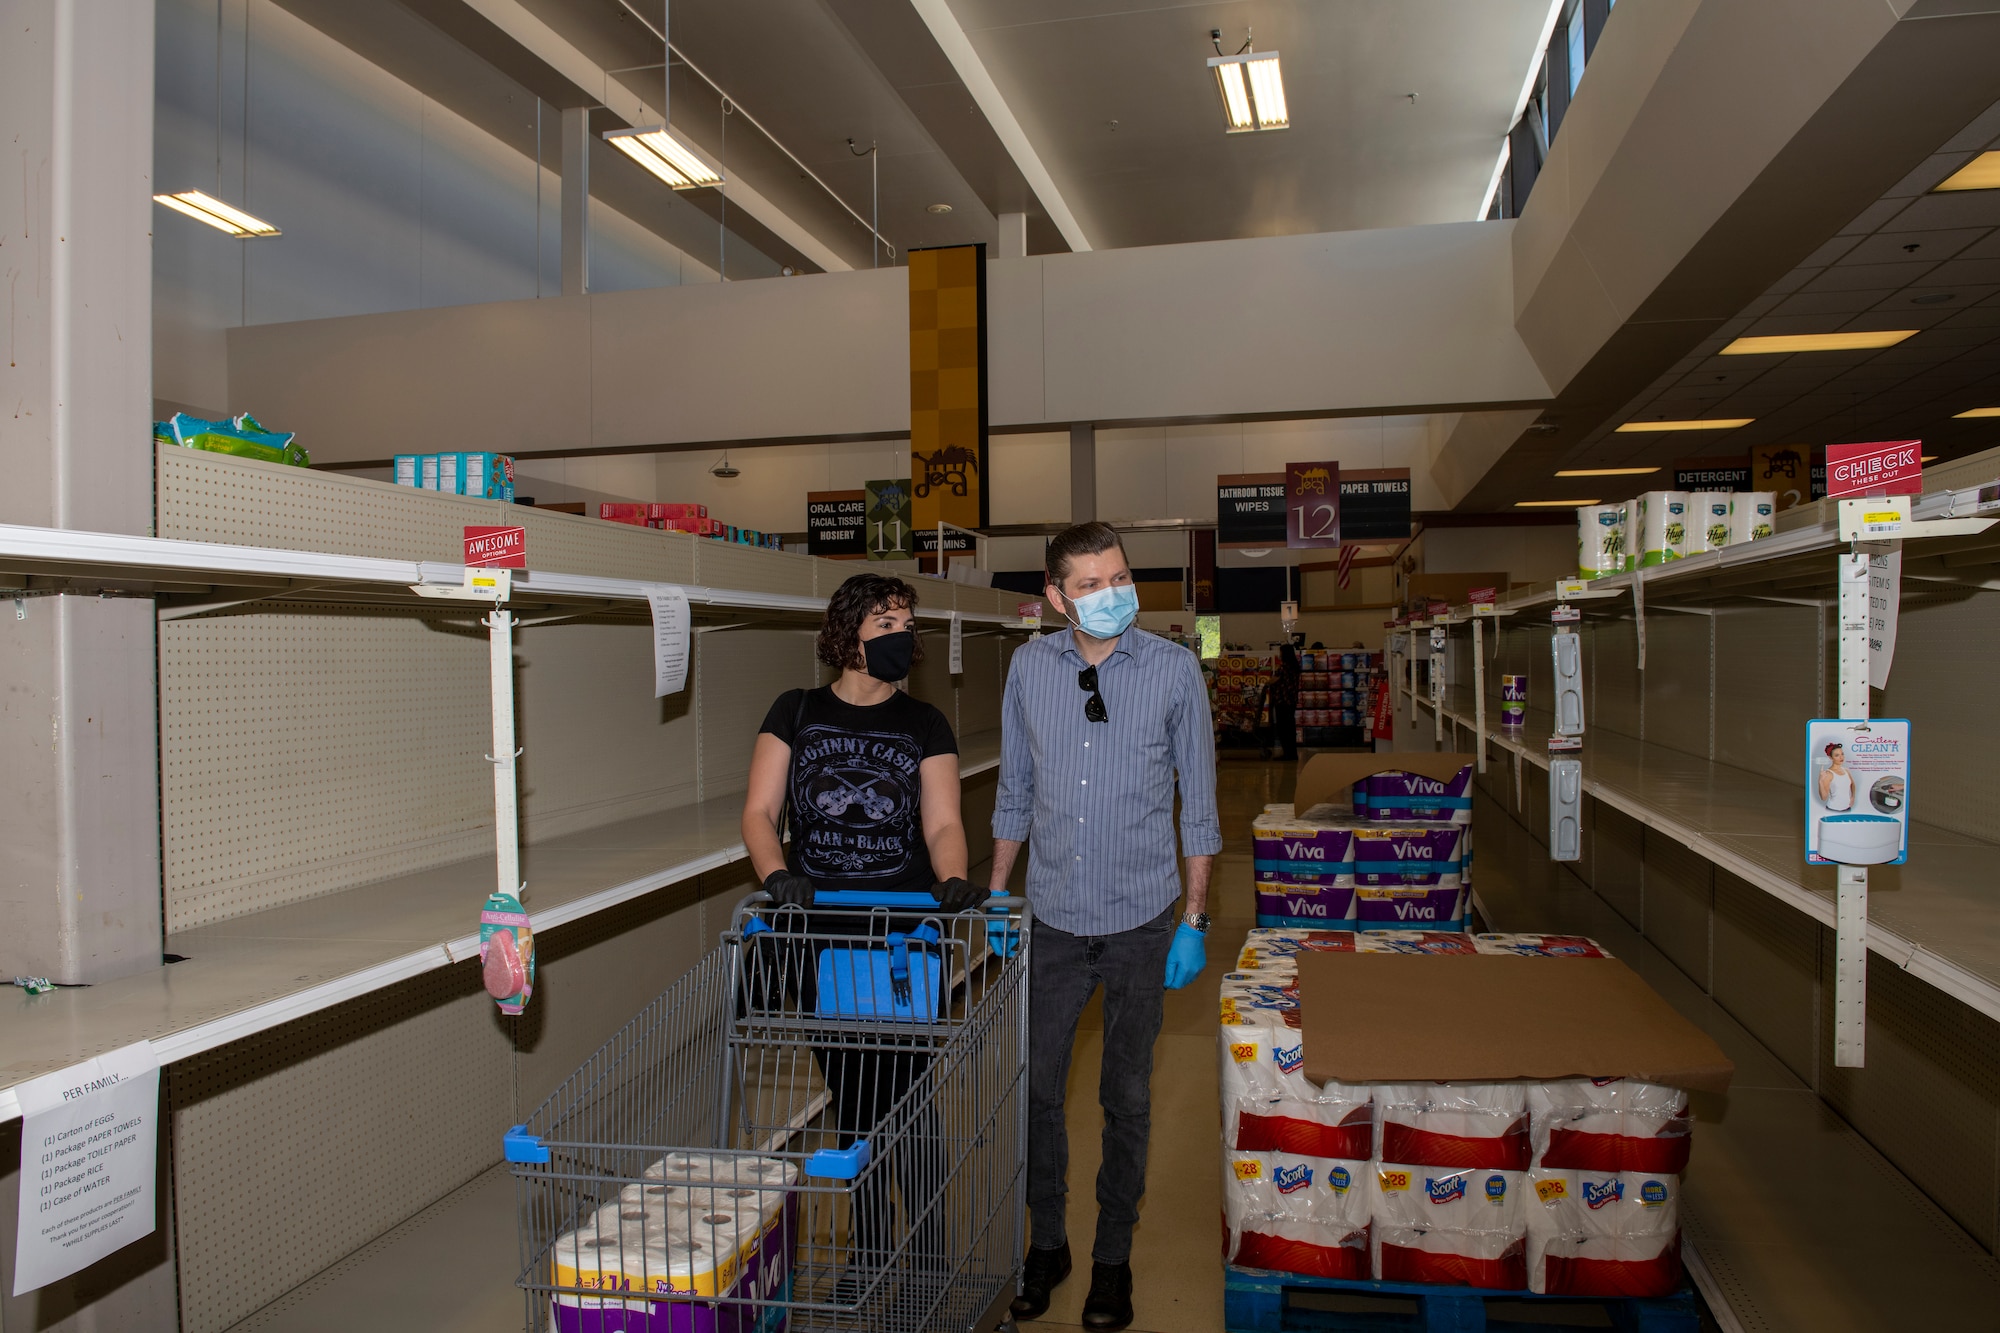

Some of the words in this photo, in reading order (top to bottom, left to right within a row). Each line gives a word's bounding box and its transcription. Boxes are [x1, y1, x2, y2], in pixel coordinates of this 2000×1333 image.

[1834, 448, 1915, 482] CHECK
[1678, 470, 1747, 483] DETERGENT
[1851, 474, 1879, 487] THESE
[1882, 469, 1900, 479] OUT
[1219, 487, 1257, 499] BATHROOM
[1259, 486, 1285, 497] TISSUE
[1341, 483, 1369, 494] PAPER
[1372, 482, 1408, 493] TOWELS
[810, 503, 836, 513] ORAL
[838, 502, 865, 513] CARE
[1235, 501, 1270, 512] WIPES
[810, 517, 837, 527] FACIAL
[837, 516, 864, 526] TISSUE
[1292, 504, 1336, 541] 12
[820, 530, 855, 541] HOSIERY
[872, 520, 907, 553] 11
[1665, 527, 1685, 540] Huge
[1707, 528, 1728, 541] Huge
[468, 532, 520, 555] AWESOME
[923, 539, 967, 550] VITMINS
[481, 549, 507, 559] OPTIONS
[1872, 576, 1884, 588] ITEM
[1885, 578, 1890, 590] IS
[1880, 598, 1887, 610] TO
[1875, 618, 1885, 632] PER
[1504, 687, 1526, 701] Viva
[1378, 692, 1389, 731] UNEXPECTED
[1855, 736, 1899, 747] Cutlery
[800, 737, 870, 767] JOHNNY
[872, 742, 918, 776] CASH
[1404, 776, 1445, 795] Viva
[809, 829, 843, 847] MAN
[857, 834, 903, 851] BLACK
[1284, 841, 1325, 860] Viva
[1392, 840, 1433, 860] Viva
[1287, 897, 1327, 917] Viva
[1394, 901, 1435, 920] Viva
[485, 912, 526, 923] Anti-Cellulite
[1238, 1046, 1253, 1057] 28
[62, 1085, 84, 1101] PER
[84, 1073, 129, 1096] FAMILY...
[44, 1135, 56, 1148] (1)
[57, 1124, 83, 1142] Carton
[84, 1119, 94, 1132] of
[94, 1113, 115, 1128] EGGS
[41, 1152, 54, 1165] (1)
[54, 1140, 86, 1160] Package
[87, 1130, 112, 1146] PAPER
[113, 1116, 142, 1134] TOWELS
[41, 1168, 53, 1181] (1)
[54, 1156, 86, 1175] Package
[87, 1145, 113, 1160] TOILET
[114, 1134, 137, 1150] PAPER
[1242, 1163, 1258, 1174] 28
[1279, 1163, 1305, 1186] Scott
[1331, 1171, 1347, 1180] MORE
[40, 1184, 52, 1197] (1)
[53, 1172, 86, 1190] Package
[87, 1163, 104, 1177] RICE
[1390, 1174, 1406, 1186] 28
[1431, 1175, 1460, 1196] Scott
[39, 1200, 52, 1213] (1)
[53, 1193, 72, 1206] Case
[73, 1187, 82, 1198] of
[83, 1175, 111, 1193] WATER
[1539, 1187, 1548, 1195] 15
[1589, 1178, 1617, 1201] Scott
[1644, 1186, 1663, 1194] MORE
[41, 1225, 56, 1235] Each
[64, 1214, 79, 1225] these
[80, 1205, 103, 1220] products
[104, 1200, 113, 1208] are
[113, 1195, 123, 1204] PER
[123, 1185, 142, 1199] FAMILY
[50, 1233, 67, 1243] Thank
[68, 1228, 78, 1236] you
[79, 1223, 87, 1231] for
[88, 1216, 100, 1227] your
[84, 1225, 108, 1240] SUPPLIES
